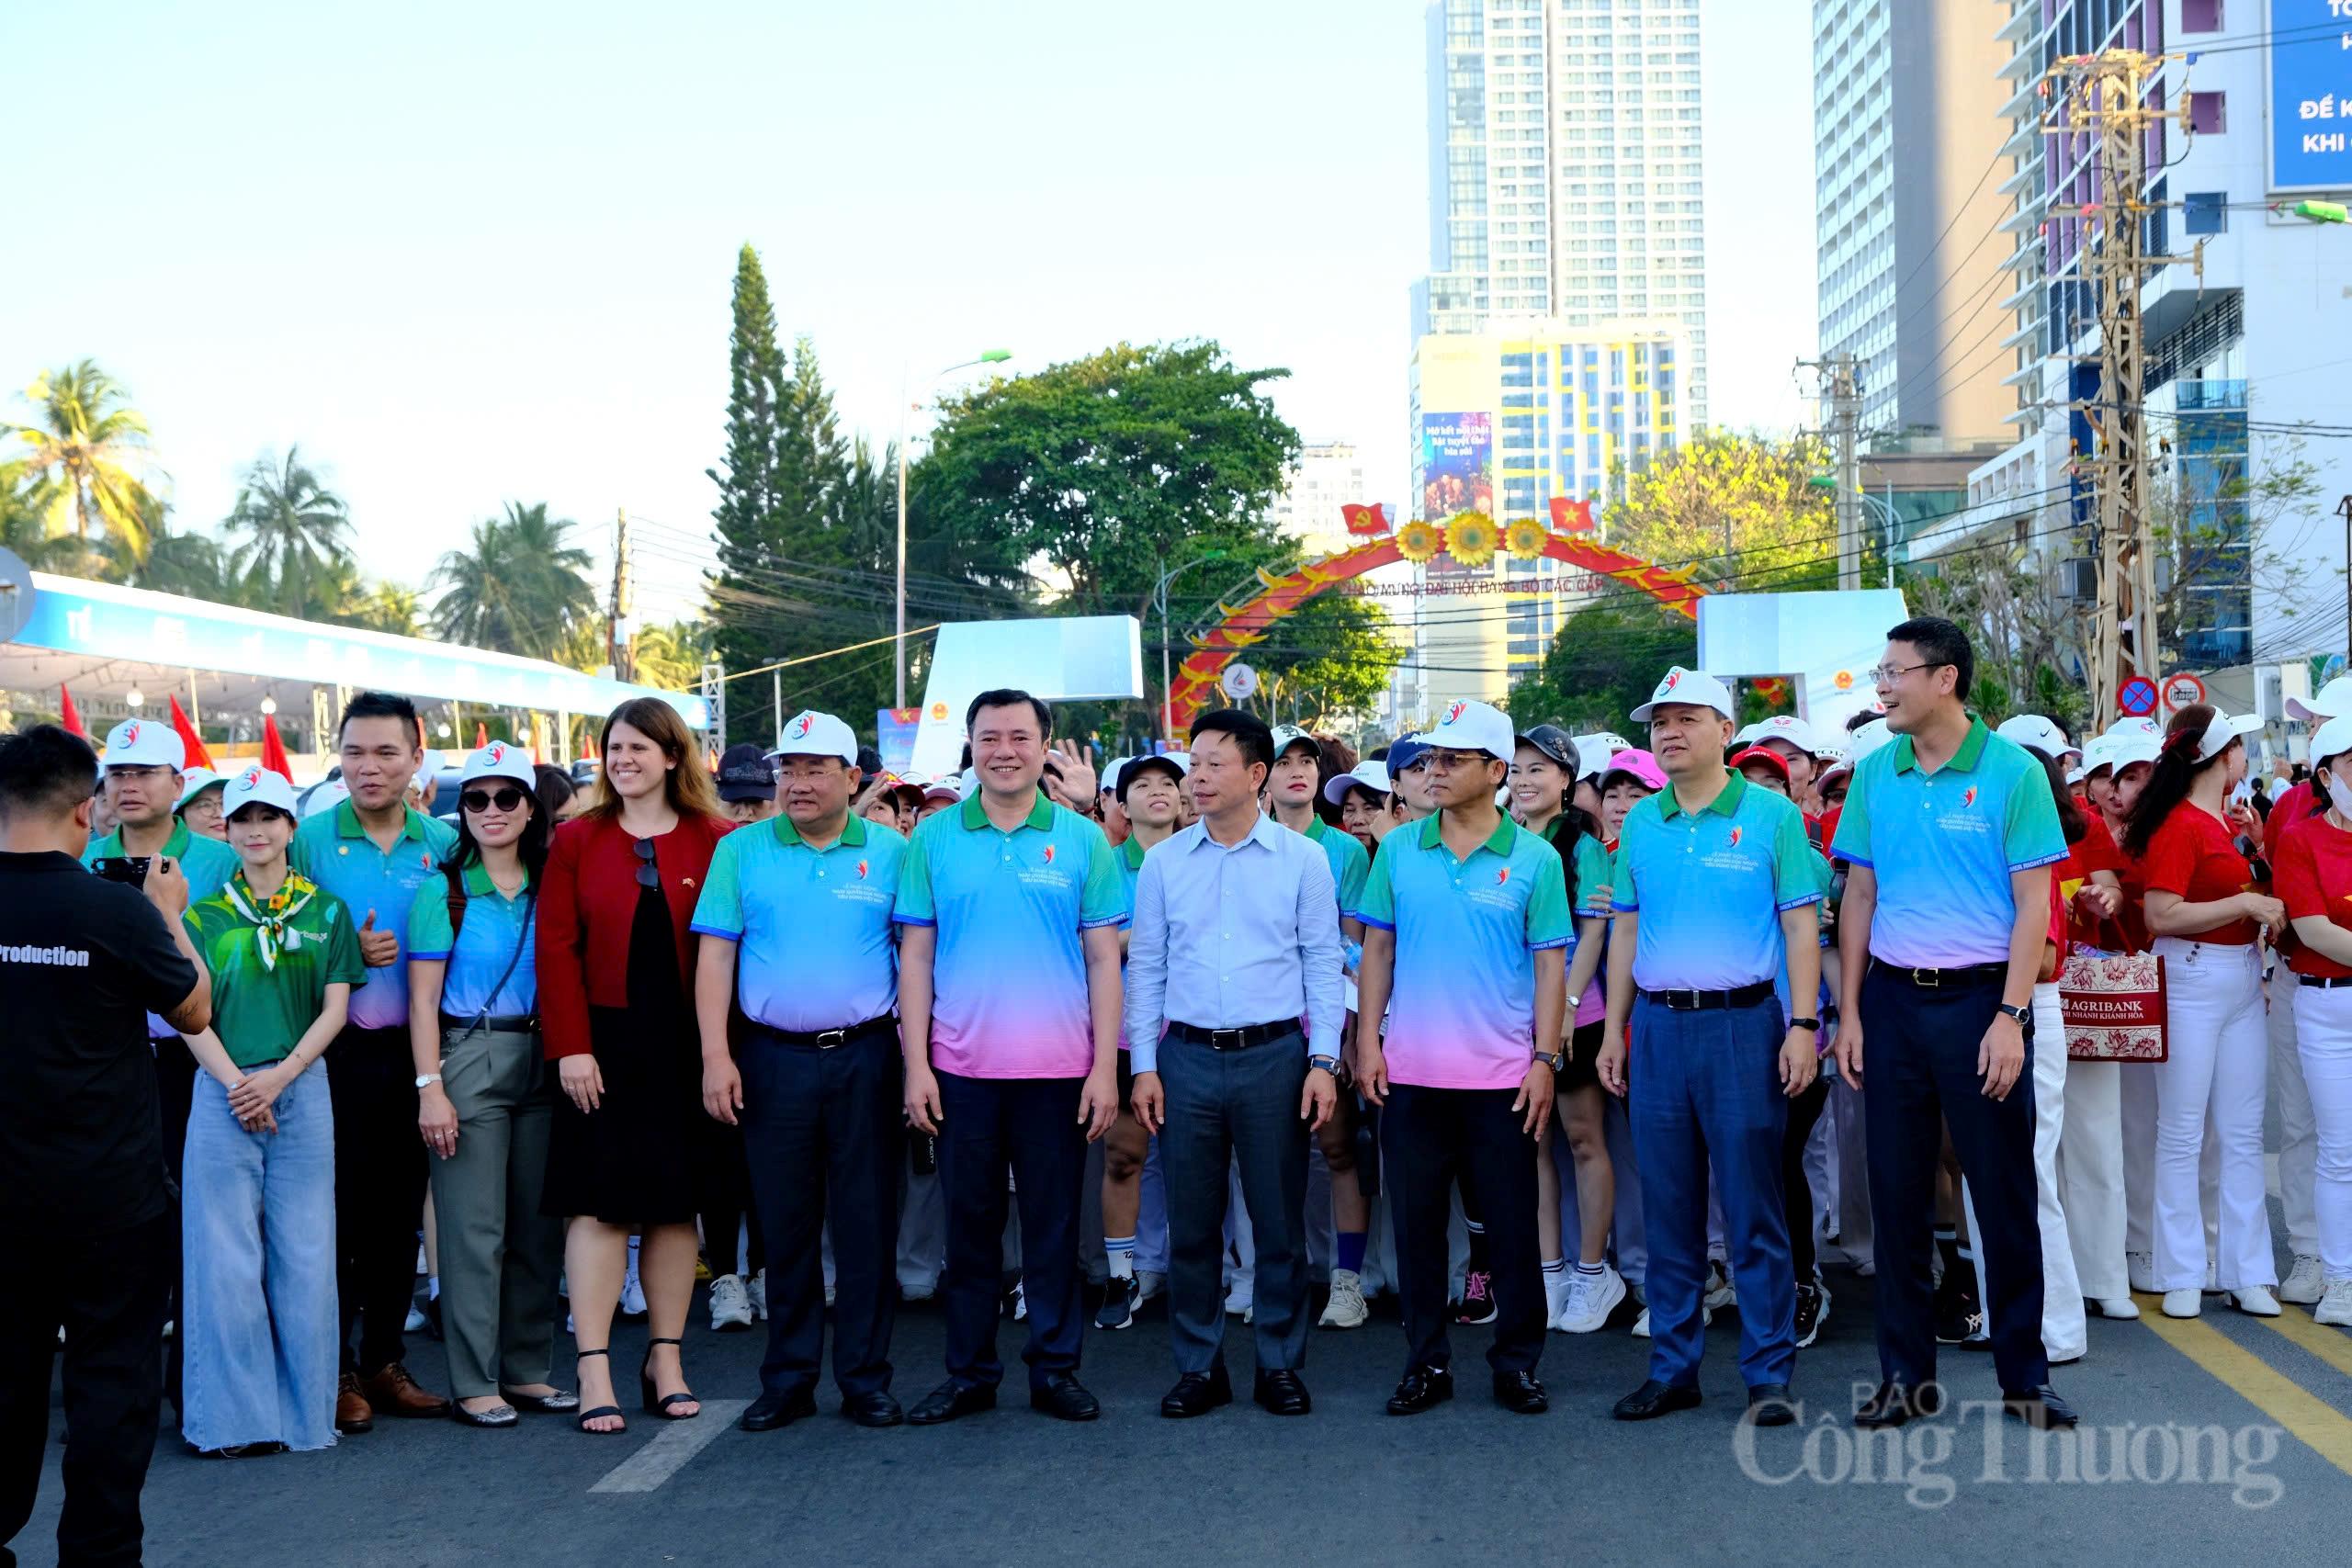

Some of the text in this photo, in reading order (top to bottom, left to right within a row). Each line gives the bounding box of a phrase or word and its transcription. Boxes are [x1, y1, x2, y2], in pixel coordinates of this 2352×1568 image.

[2302, 133, 2345, 153] KHI
[2023, 859, 2043, 870] RIGHT
[0, 944, 89, 966] roduction
[2071, 1000, 2143, 1011] AGRIBANK
